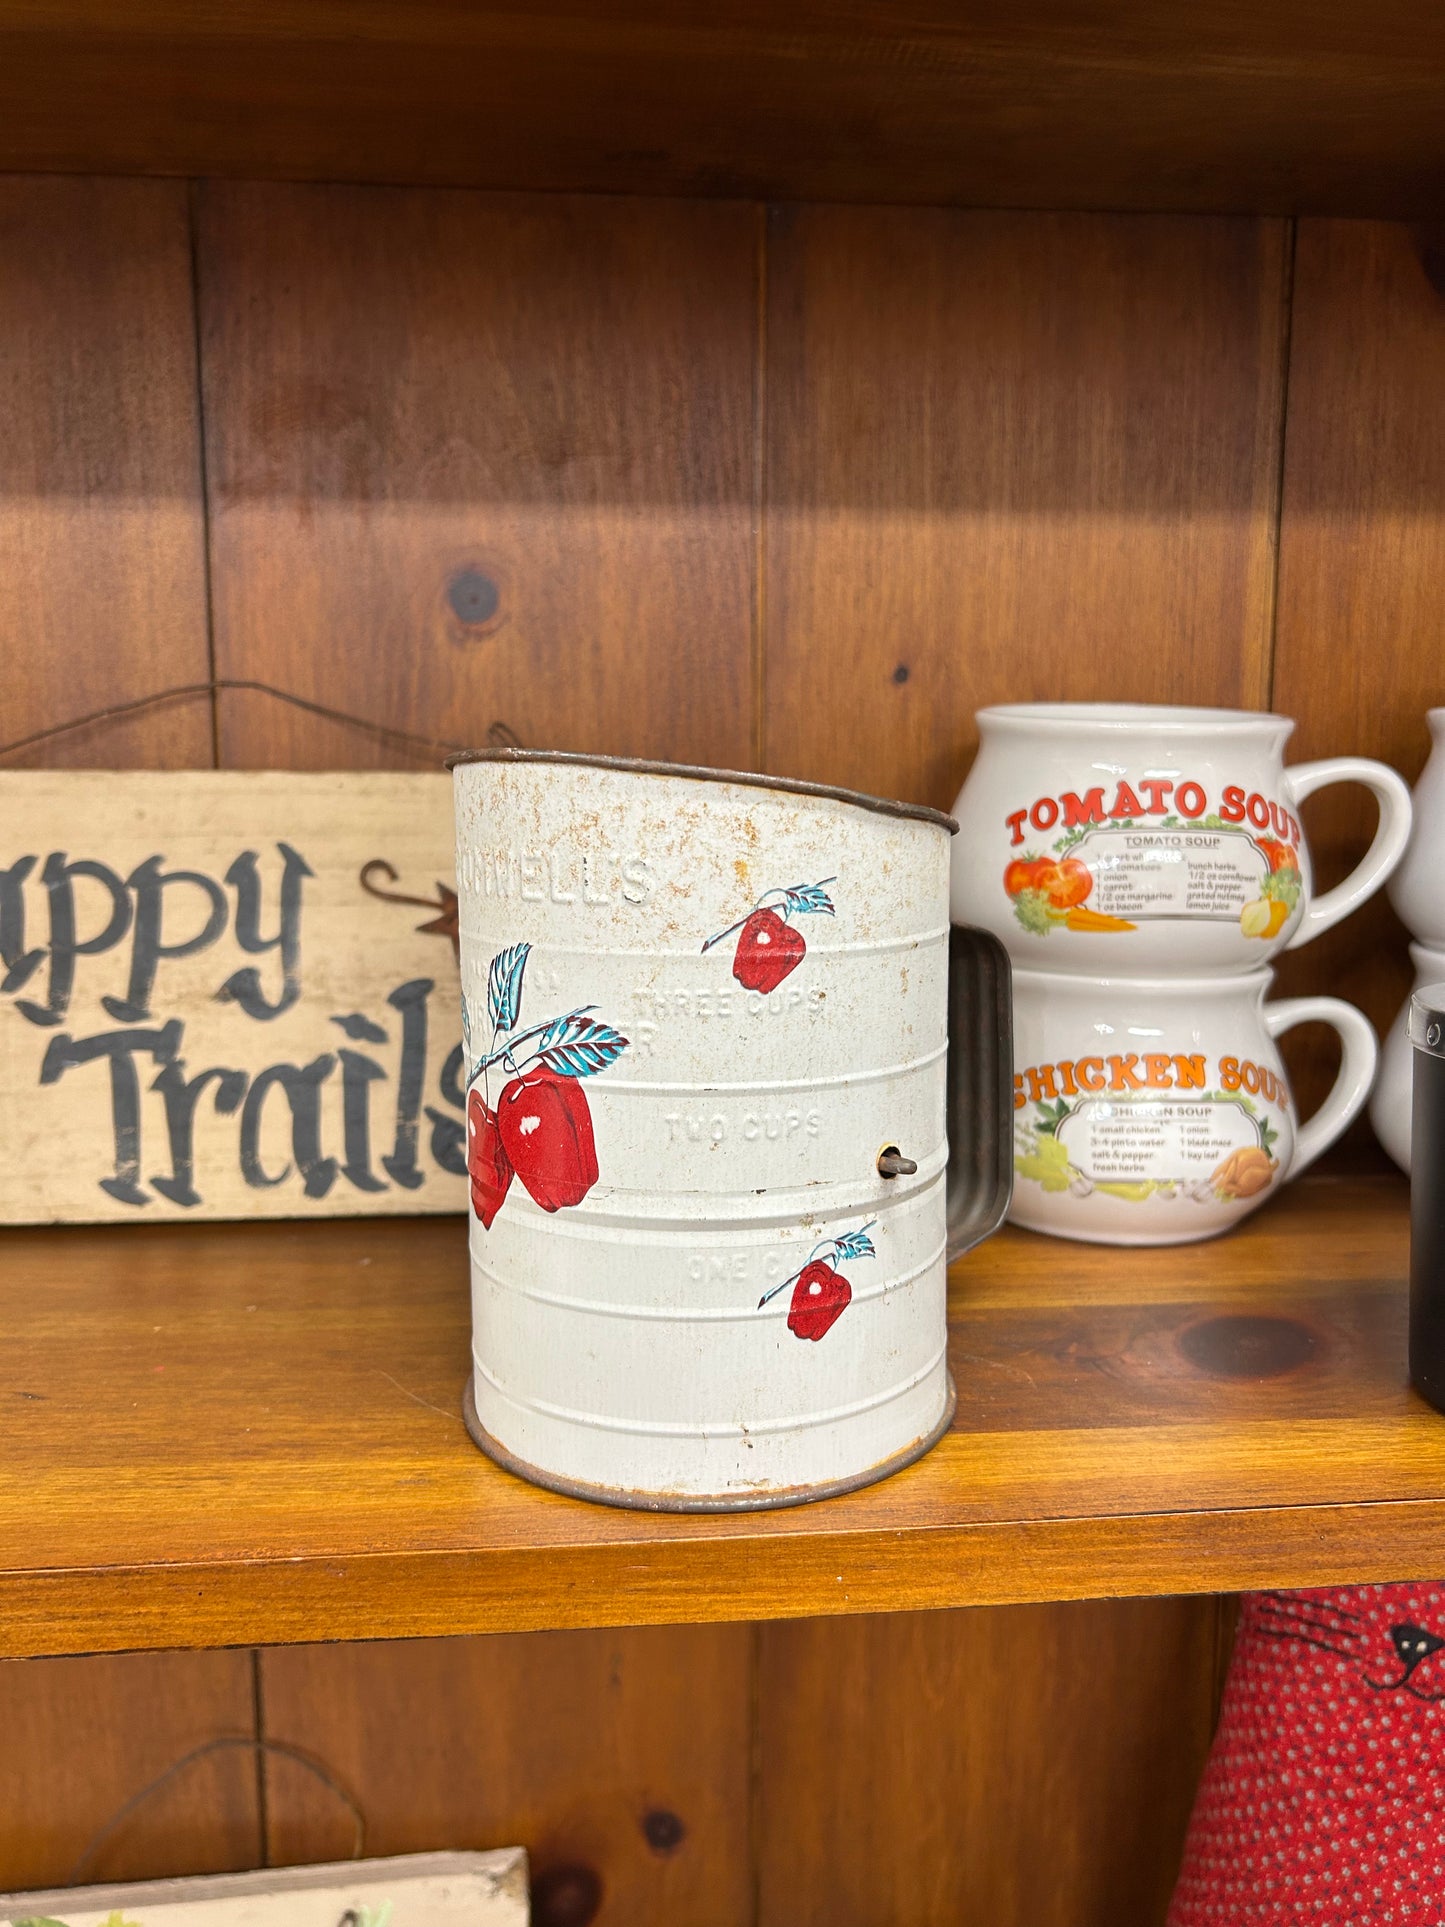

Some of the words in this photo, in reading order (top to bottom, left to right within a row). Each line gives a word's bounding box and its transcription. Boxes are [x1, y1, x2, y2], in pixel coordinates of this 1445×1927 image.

[1005, 781, 1207, 846] TOMATO
[1219, 786, 1301, 848] SOUP
[1125, 837, 1181, 846] TOMATO
[1185, 837, 1220, 847] SOUP
[1187, 862, 1213, 870] bunch
[1104, 873, 1128, 881] onion
[1104, 883, 1134, 891] carrot
[1187, 882, 1206, 890] salt
[1216, 883, 1242, 893] pepper
[1128, 892, 1173, 903] margarine
[1187, 892, 1216, 902] grated
[1117, 903, 1143, 911] bacon
[1186, 902, 1212, 910] lemon
[1211, 902, 1231, 912] juice
[1219, 1057, 1289, 1111] SOUP
[1176, 1107, 1212, 1117] SOUP
[743, 1110, 819, 1141] CUPS
[1122, 1151, 1153, 1162] pepper
